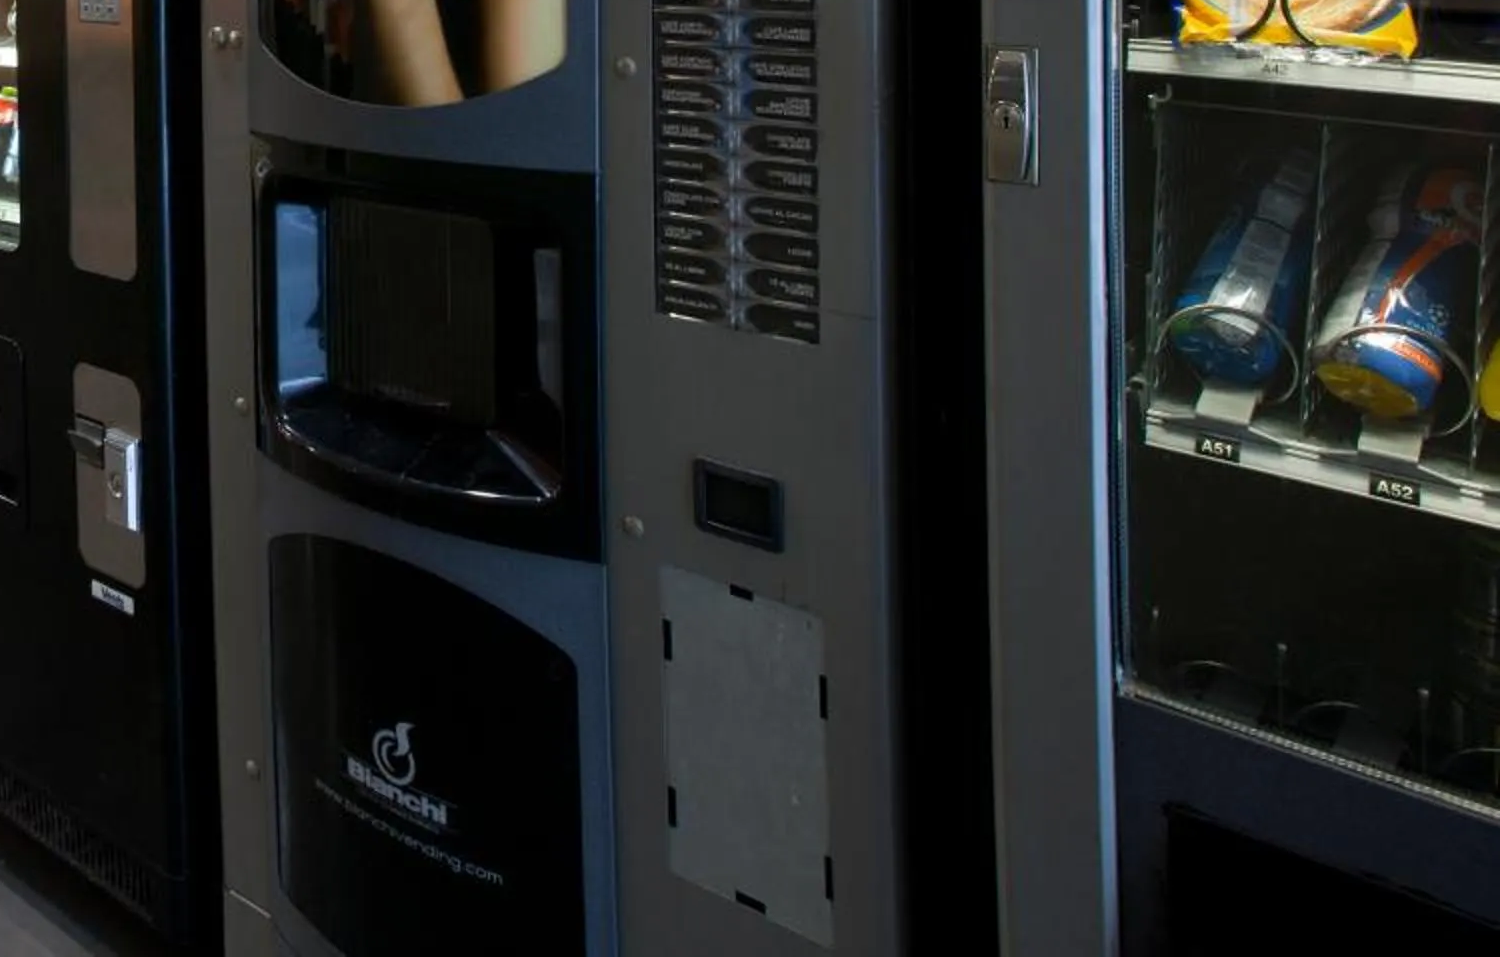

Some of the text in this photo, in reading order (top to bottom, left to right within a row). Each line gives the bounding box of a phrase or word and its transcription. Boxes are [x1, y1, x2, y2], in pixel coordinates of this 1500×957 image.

[1201, 438, 1233, 458] A51
[1376, 479, 1414, 500] A52
[347, 756, 448, 825] Bianchi
